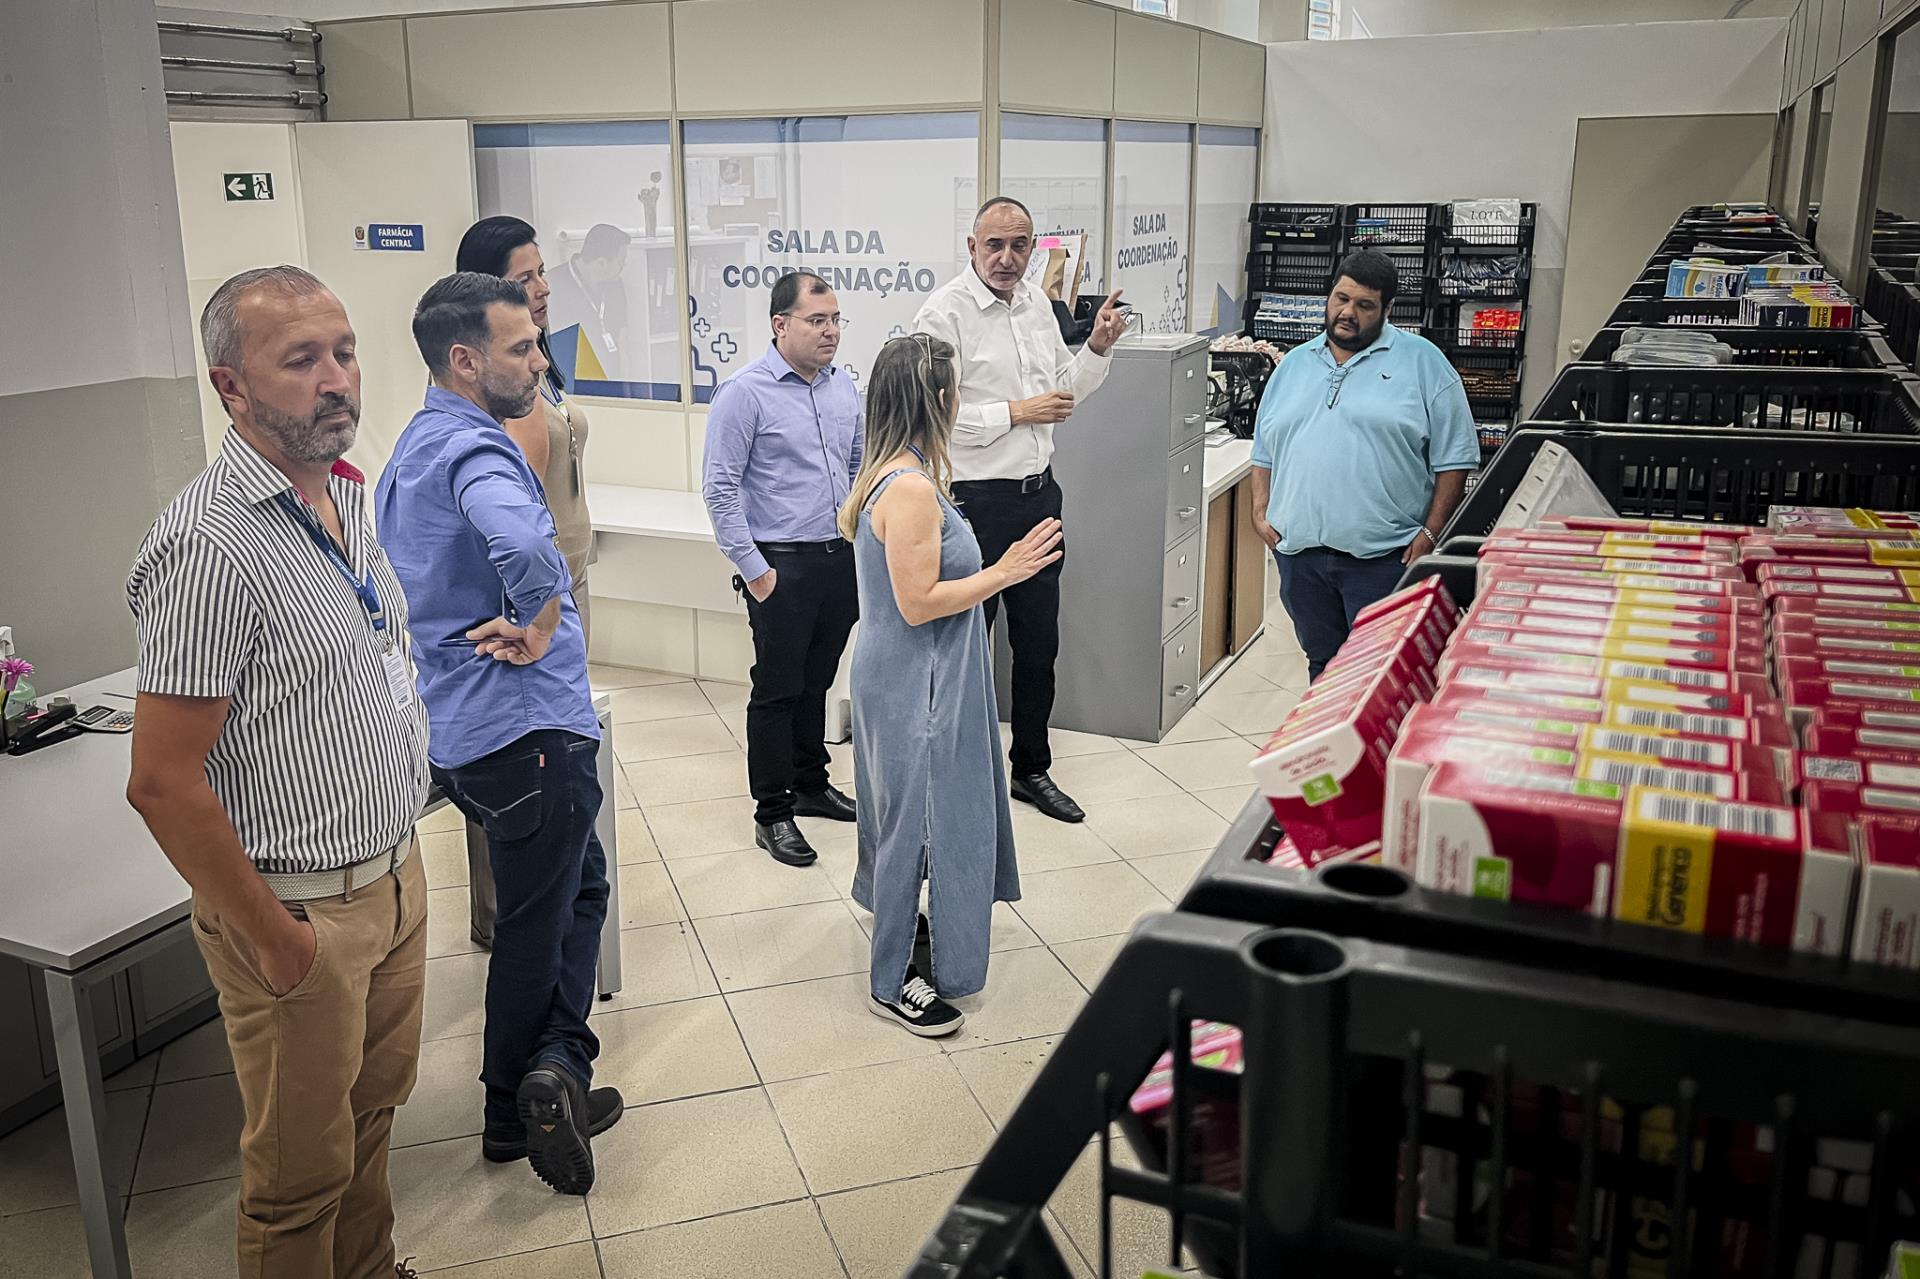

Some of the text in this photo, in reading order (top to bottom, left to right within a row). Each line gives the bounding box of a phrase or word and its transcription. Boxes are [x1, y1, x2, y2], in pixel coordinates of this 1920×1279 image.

[378, 226, 414, 237] FARMÁCIA
[1133, 213, 1166, 236] SALA DA
[381, 238, 412, 248] CENTRAL
[767, 229, 885, 254] SALA DA
[1118, 236, 1178, 269] COORDENAÇÃO
